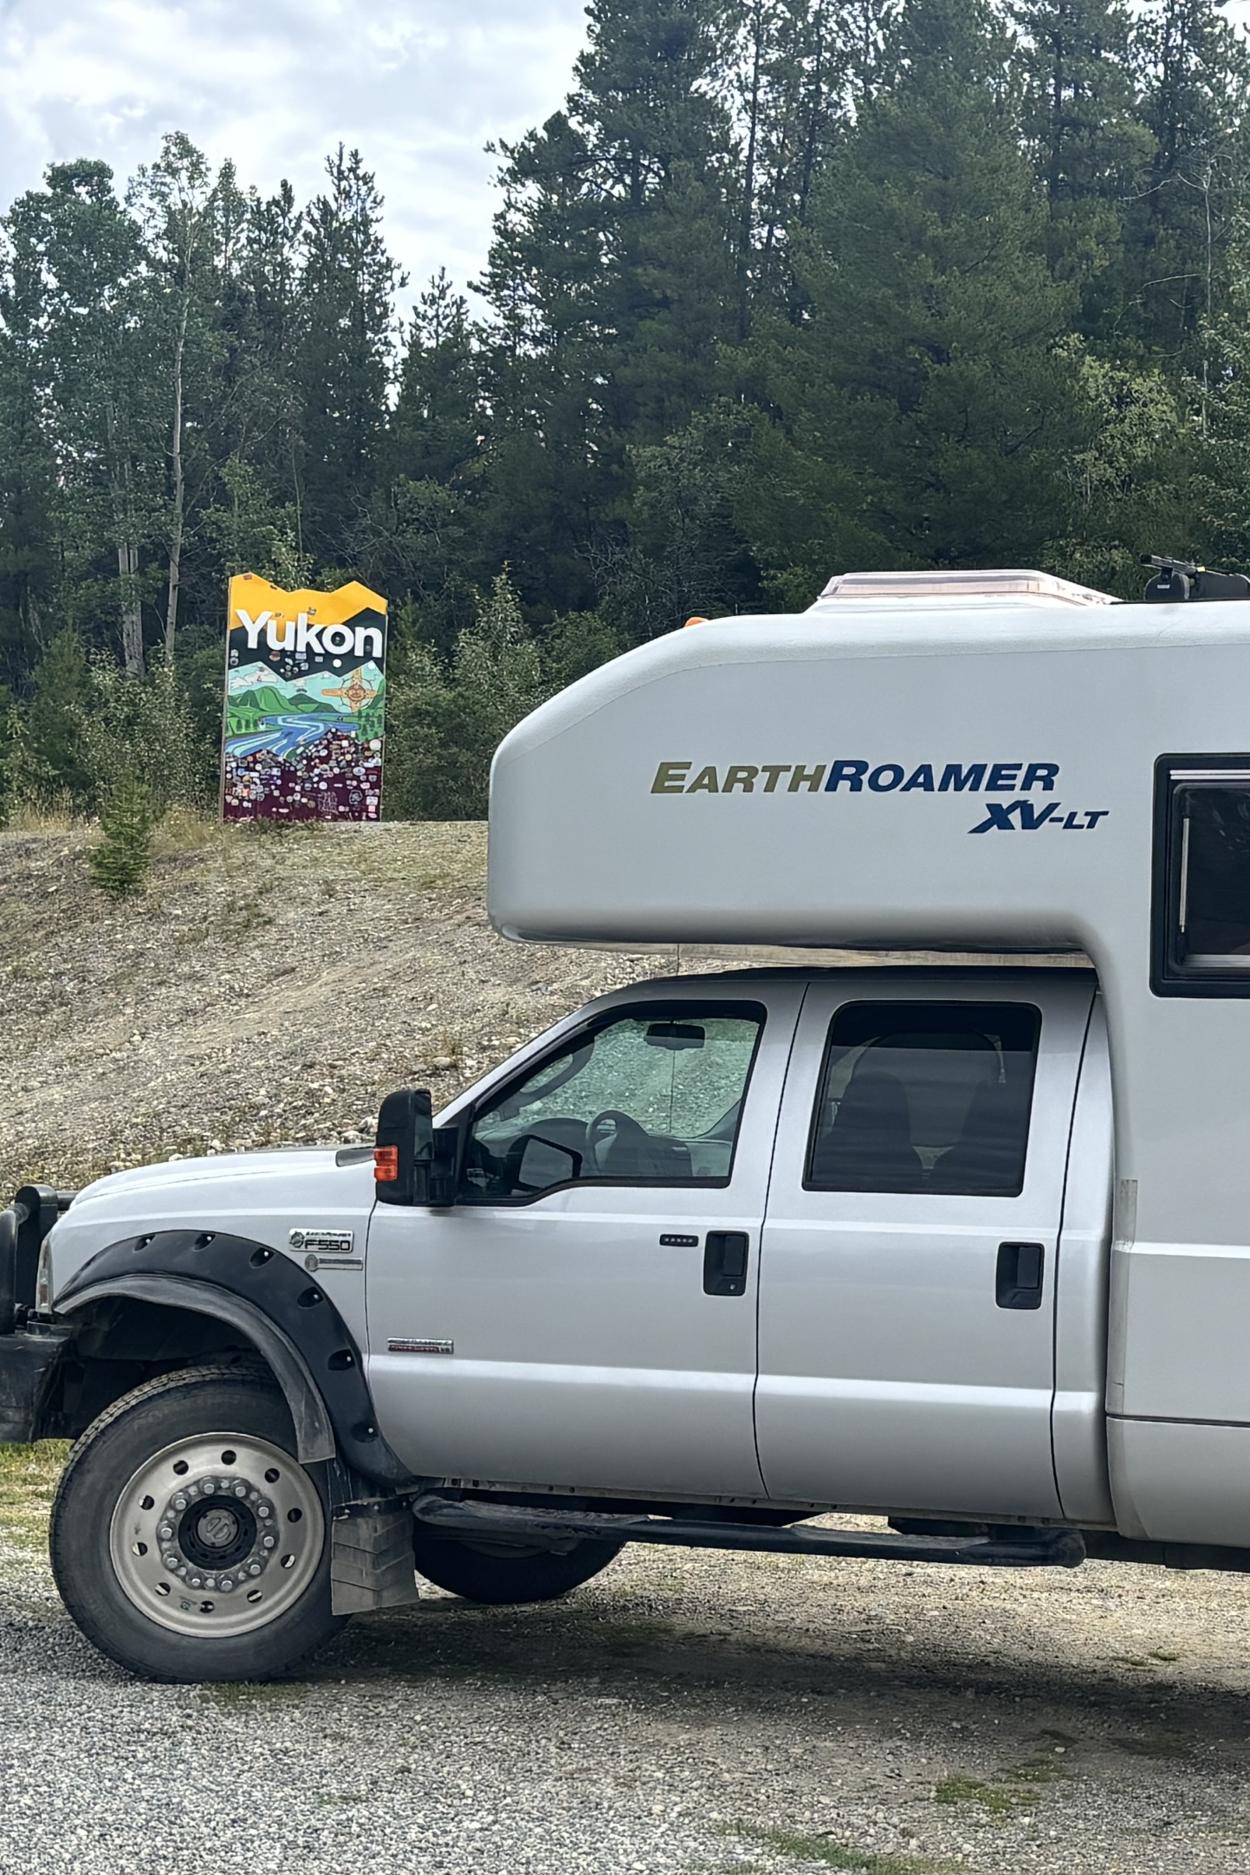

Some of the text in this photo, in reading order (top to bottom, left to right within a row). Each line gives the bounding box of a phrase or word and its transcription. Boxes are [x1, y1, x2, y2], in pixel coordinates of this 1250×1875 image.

[235, 608, 383, 658] Yukon
[650, 759, 1060, 794] EARTHROAMER
[967, 799, 1110, 835] XV-LT
[304, 1238, 351, 1251] F550
